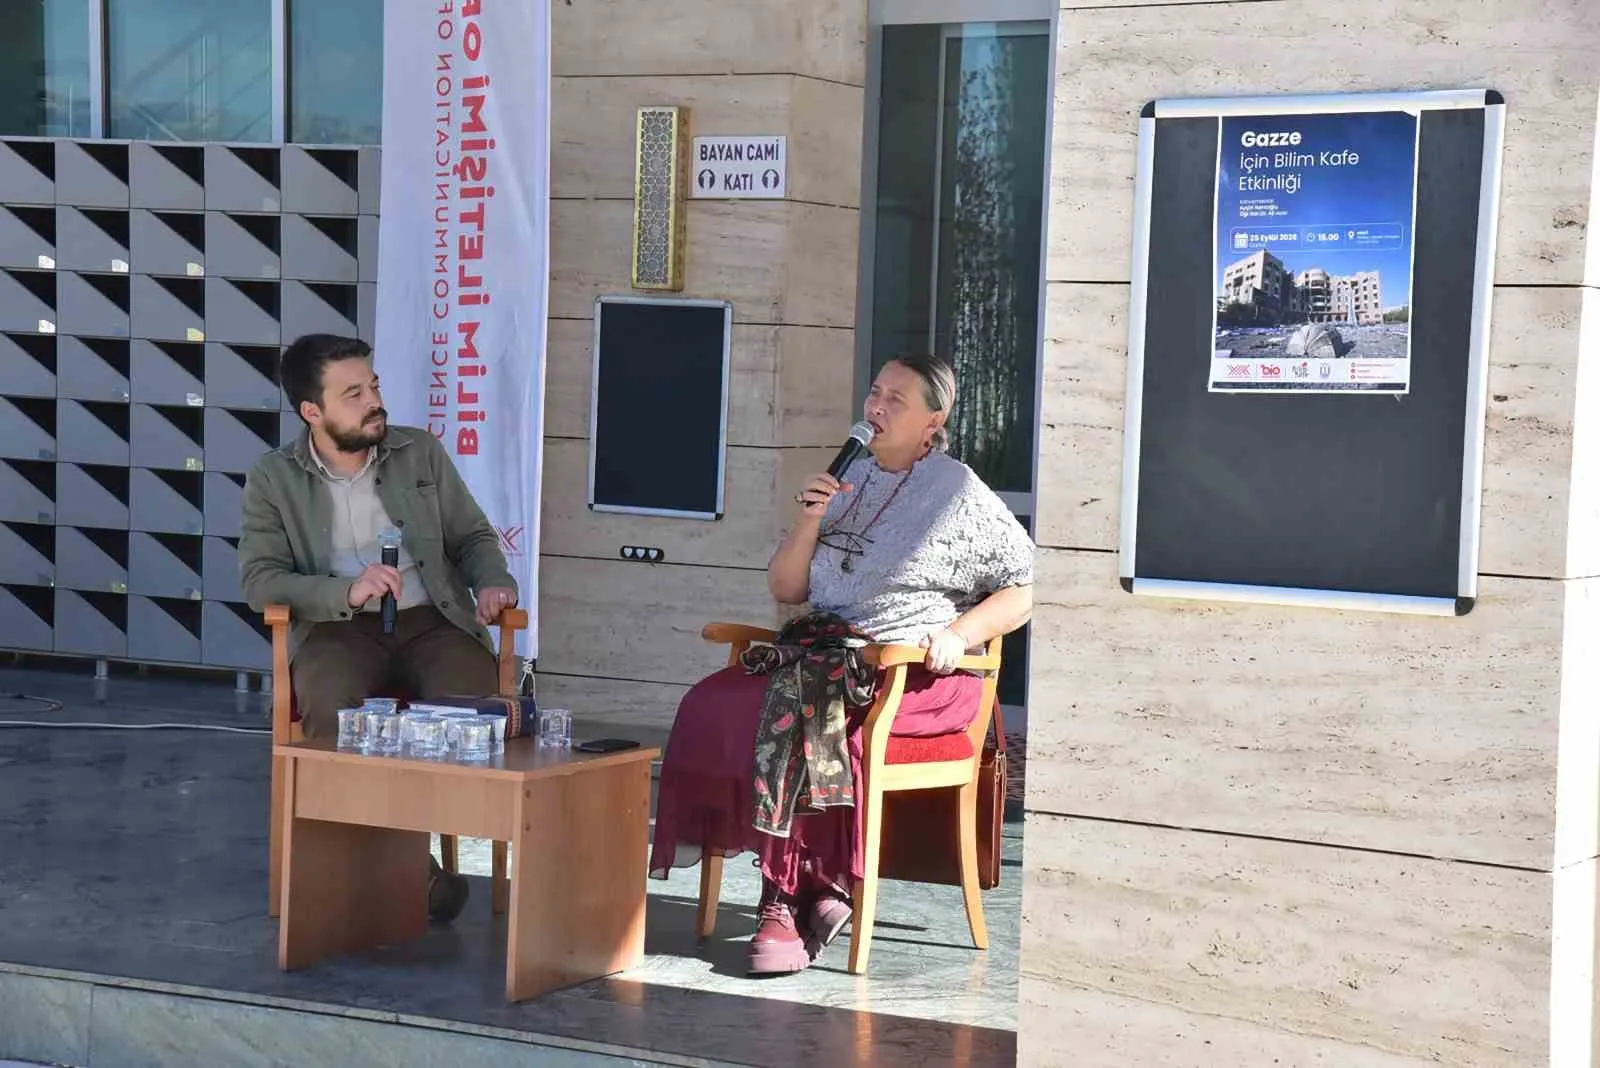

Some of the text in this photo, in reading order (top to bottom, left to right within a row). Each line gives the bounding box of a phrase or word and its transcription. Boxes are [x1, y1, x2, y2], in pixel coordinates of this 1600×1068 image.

[1241, 131, 1302, 147] Gazze
[700, 139, 780, 161] BAYAN CAMİ
[1240, 149, 1360, 173] İçin Bilim Kafe
[724, 173, 753, 191] KATI
[1239, 174, 1302, 194] Etkinliği
